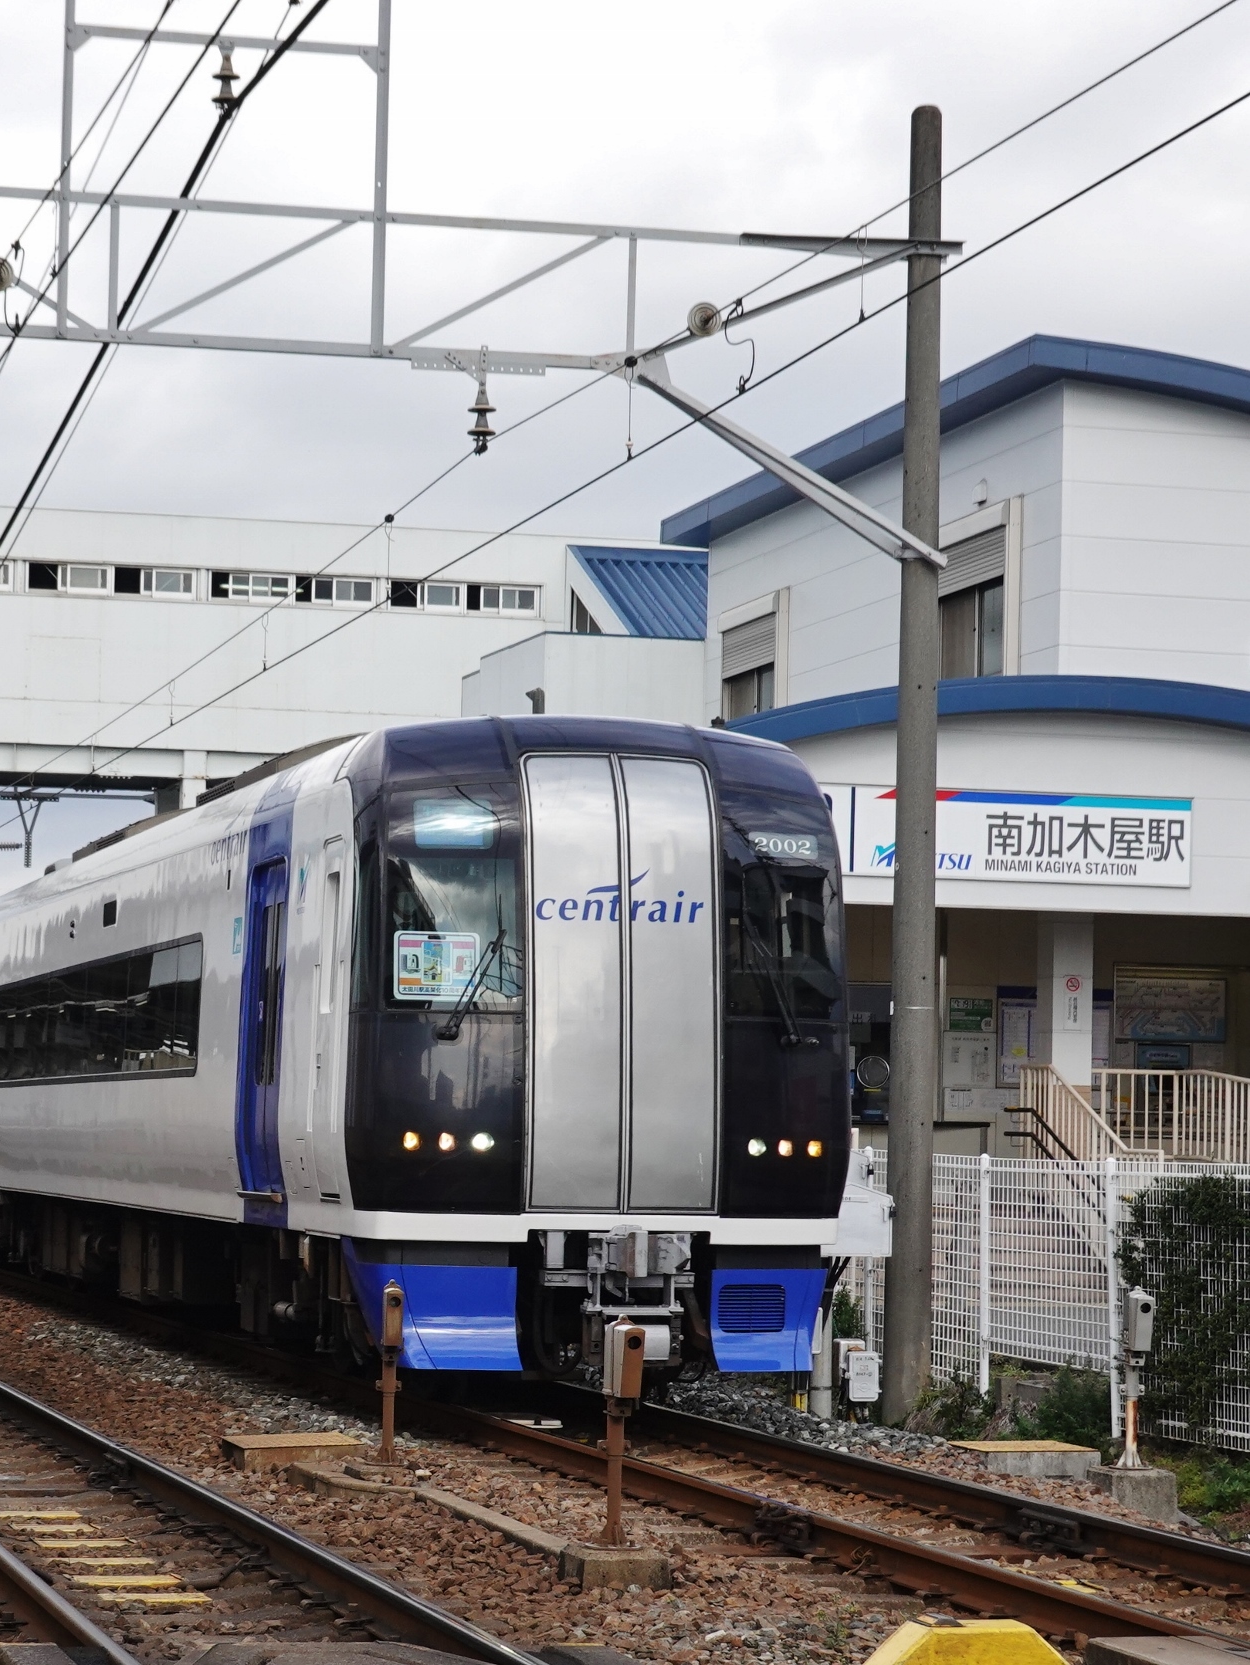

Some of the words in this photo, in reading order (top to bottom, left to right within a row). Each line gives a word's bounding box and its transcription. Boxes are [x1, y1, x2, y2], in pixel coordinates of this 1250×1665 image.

[754, 836, 812, 855] 2002
[986, 812, 1185, 862] 南加木屋駅
[985, 859, 1032, 873] MINAMI
[1036, 860, 1082, 875] KAGIYA
[1085, 862, 1137, 876] STATION
[536, 868, 704, 923] centrair
